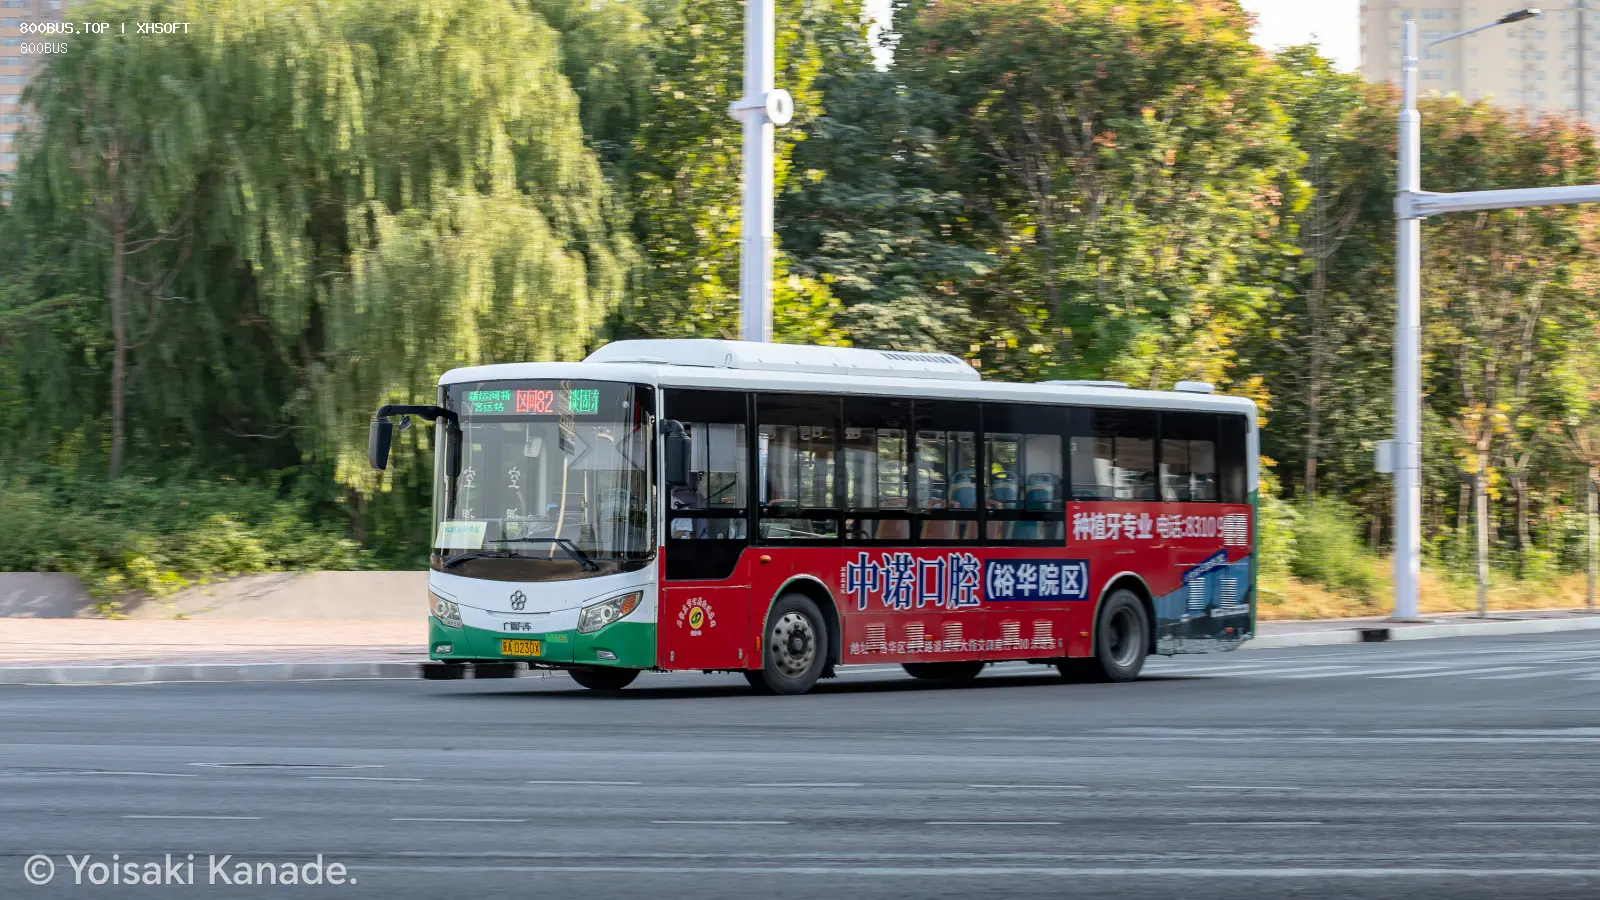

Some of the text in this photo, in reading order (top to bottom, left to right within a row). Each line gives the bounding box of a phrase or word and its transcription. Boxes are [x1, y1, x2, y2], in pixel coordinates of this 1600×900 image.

[1072, 512, 1154, 541] 种植牙专业
[846, 551, 982, 611] 中诺口腔
